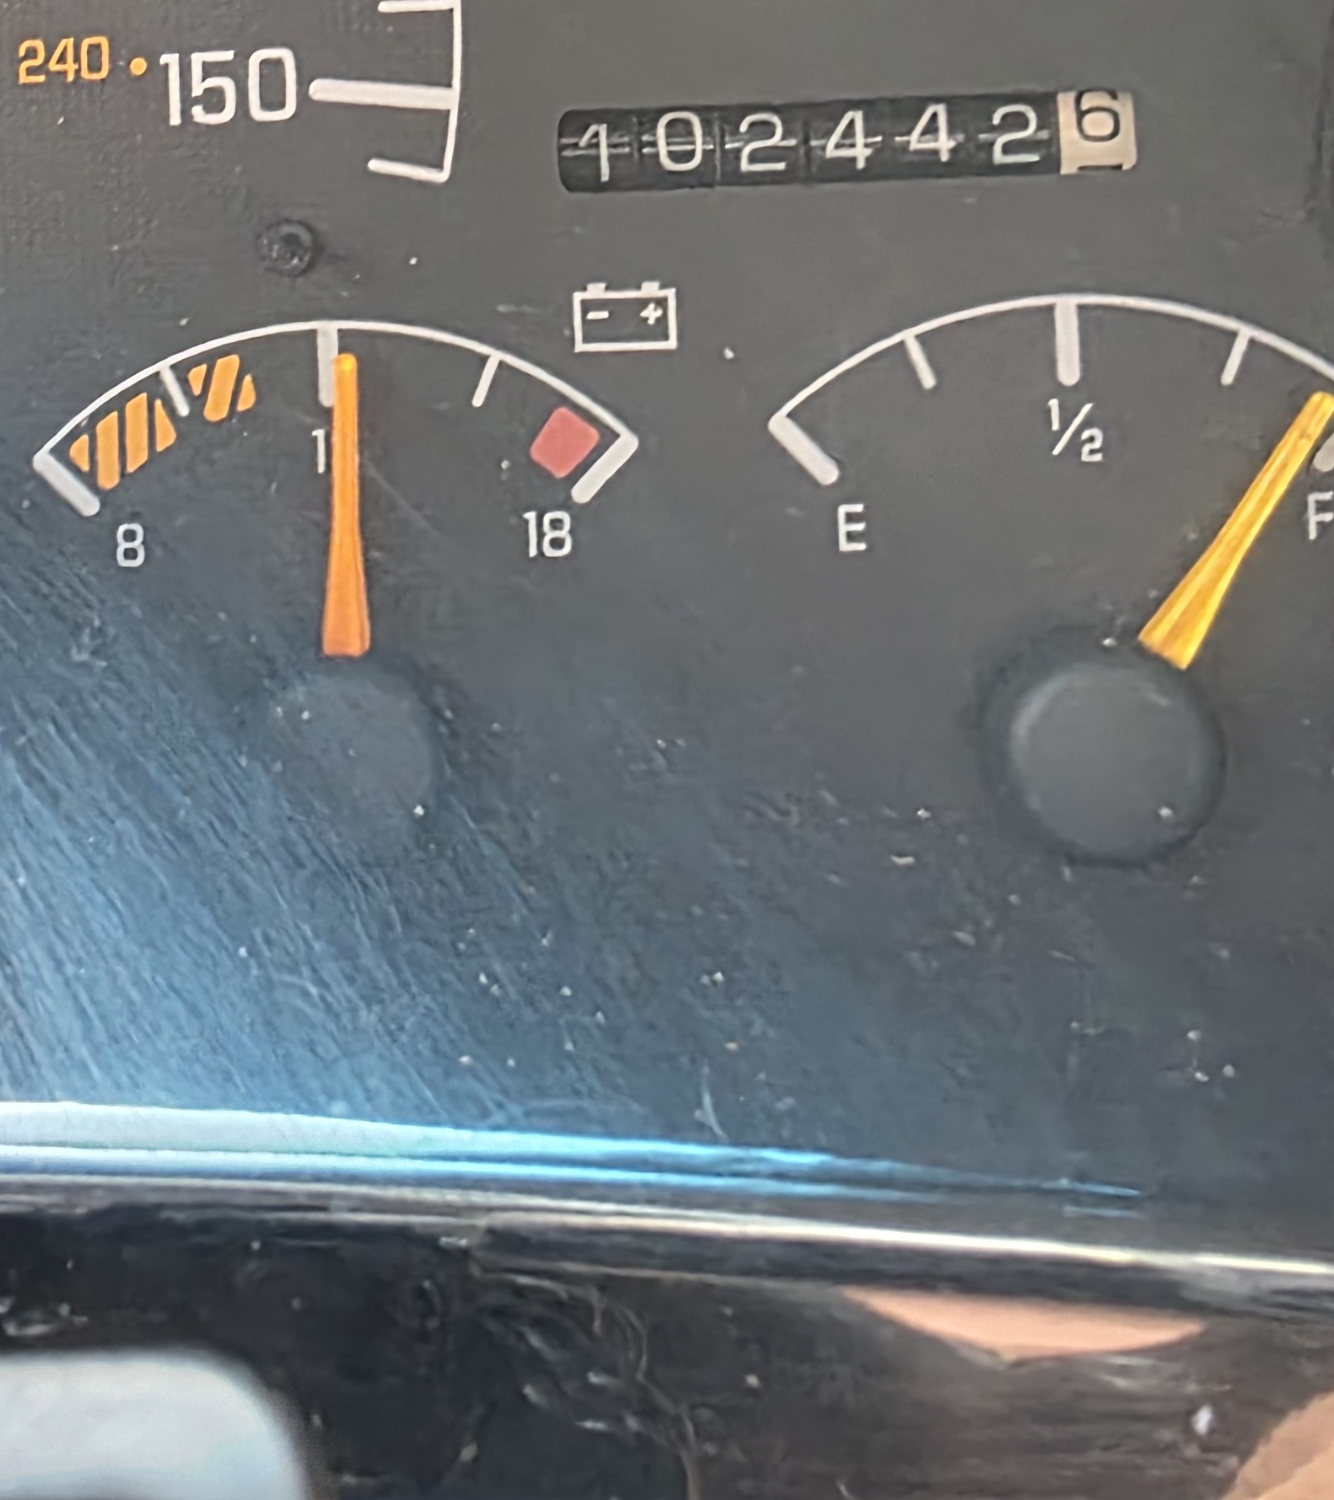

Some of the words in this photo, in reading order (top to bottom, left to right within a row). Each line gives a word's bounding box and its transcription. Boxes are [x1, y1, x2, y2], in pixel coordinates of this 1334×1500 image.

[17, 34, 111, 86] 240
[158, 46, 298, 127] 150
[522, 509, 573, 559] 18
[836, 502, 868, 553] E
[1306, 489, 1334, 541] F
[115, 522, 146, 568] 8
